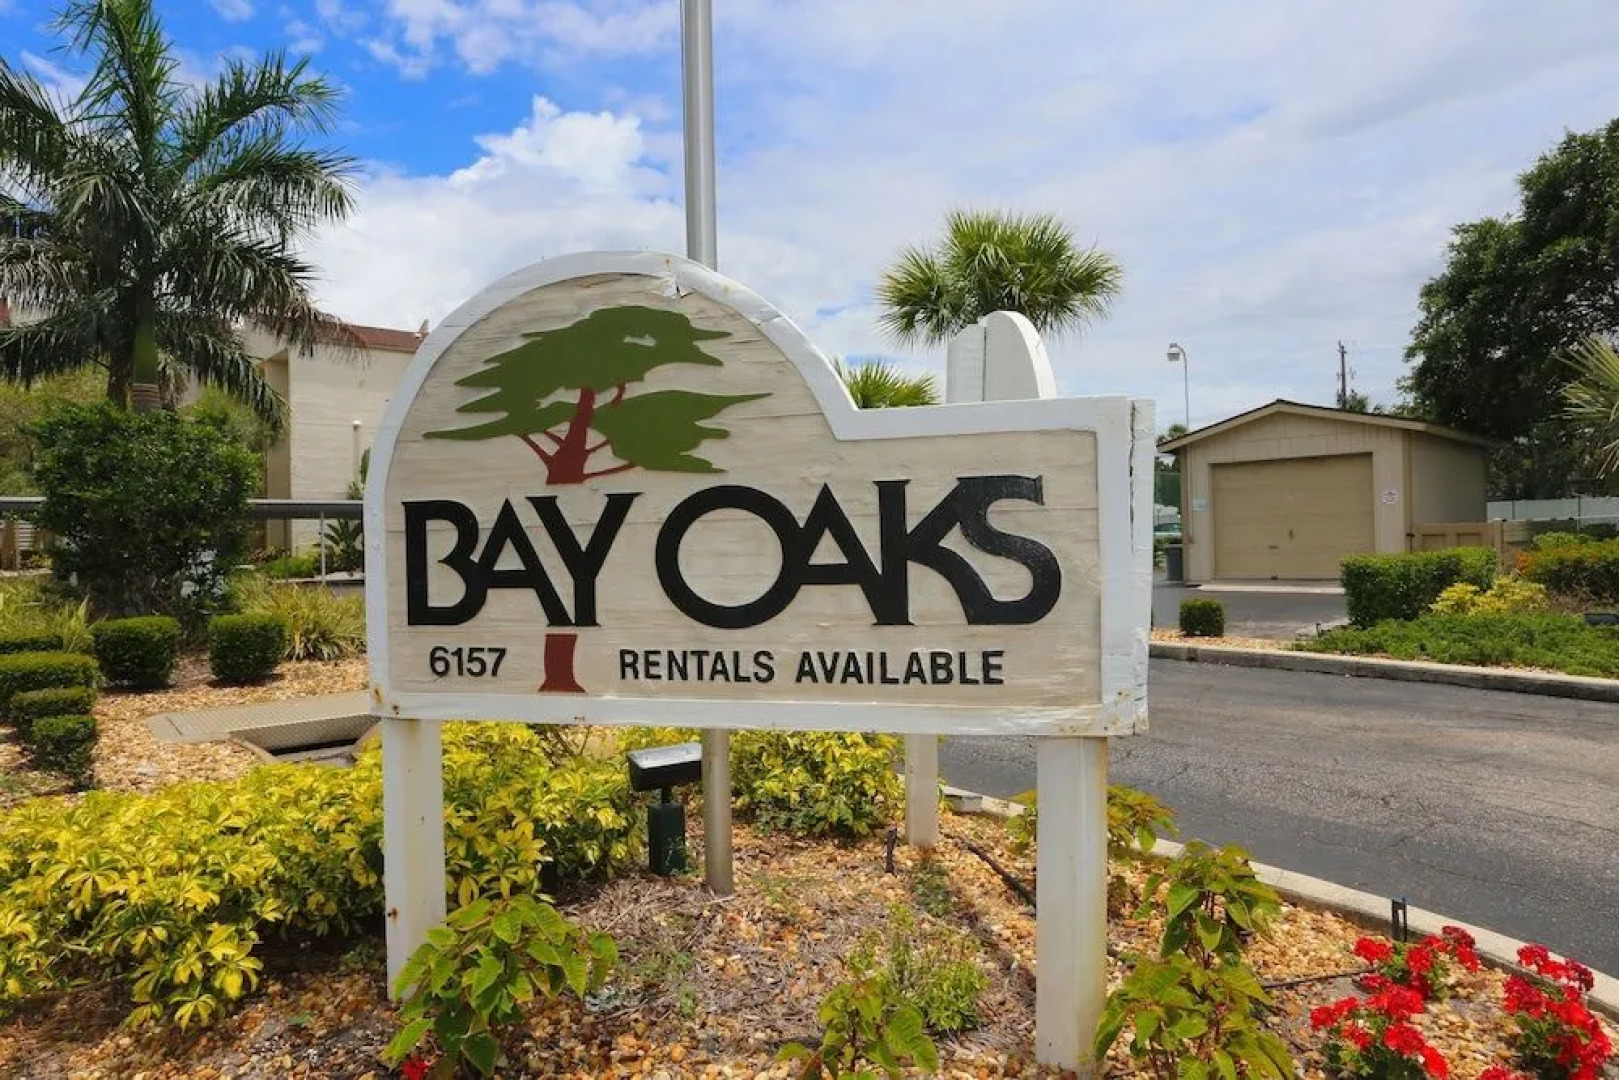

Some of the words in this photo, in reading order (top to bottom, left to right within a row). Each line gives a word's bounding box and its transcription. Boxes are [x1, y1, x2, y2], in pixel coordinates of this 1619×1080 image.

[401, 491, 643, 628] BAY
[655, 475, 1061, 630] OAKS
[429, 646, 507, 679] 6157
[619, 649, 775, 684] RENTALS
[795, 651, 1005, 686] AVAILABLE
